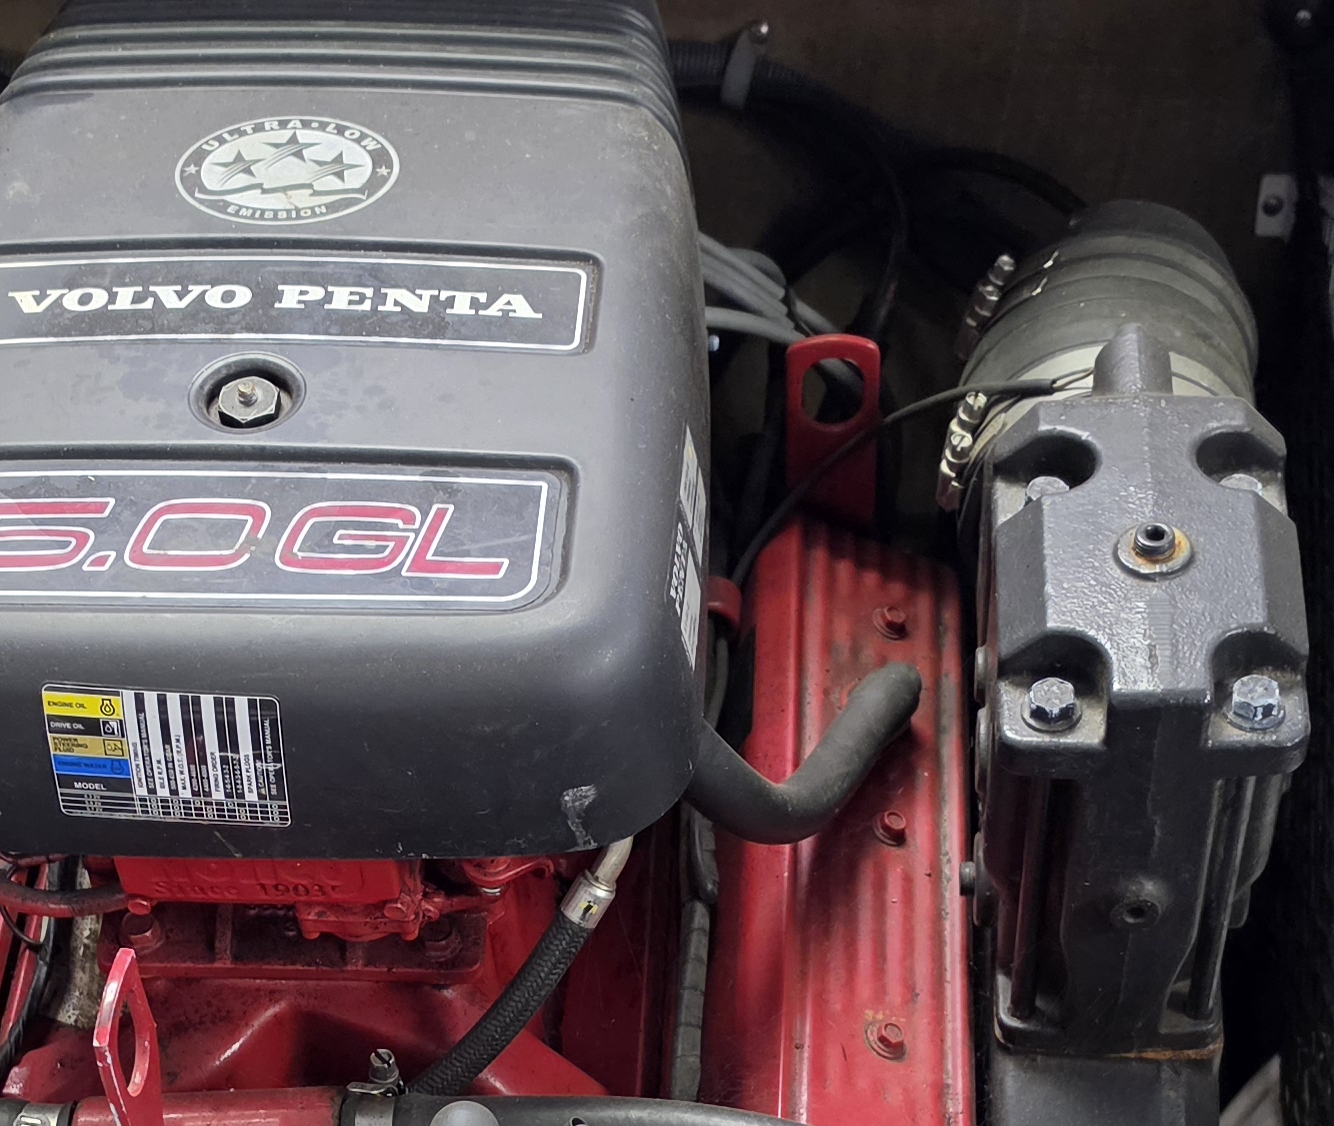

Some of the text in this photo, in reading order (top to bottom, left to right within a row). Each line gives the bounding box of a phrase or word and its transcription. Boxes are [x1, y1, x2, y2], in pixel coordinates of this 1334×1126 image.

[202, 119, 383, 152] ULTRA LOW
[226, 205, 328, 219] EMISSION
[7, 284, 543, 319] VOLVO PENTA
[47, 700, 73, 708] ENGINE
[50, 721, 85, 730] DRIVE OIL
[73, 781, 107, 791] MODEL
